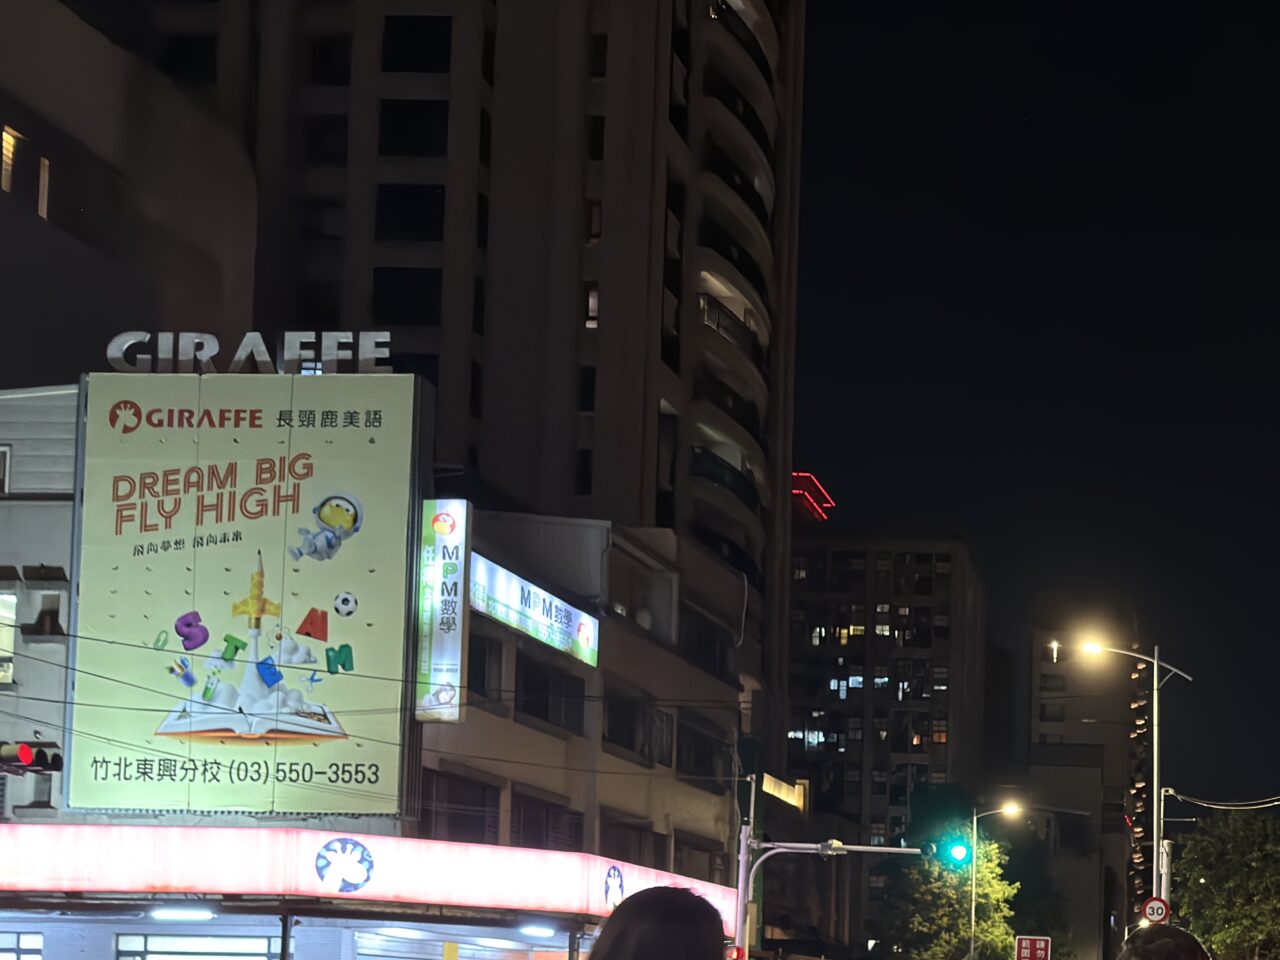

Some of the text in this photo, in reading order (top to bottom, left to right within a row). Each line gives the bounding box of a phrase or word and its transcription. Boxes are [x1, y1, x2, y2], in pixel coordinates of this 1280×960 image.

[106, 331, 394, 374] GIRAFFE
[145, 409, 263, 429] GIRAFFE
[276, 409, 383, 429] 長頸鹿美語
[112, 452, 314, 503] DREAM BIG
[115, 482, 301, 536] FLY HIGH
[90, 756, 380, 785] 竹北東興分校 (03) 550-3553
[1148, 907, 1164, 916] 30
